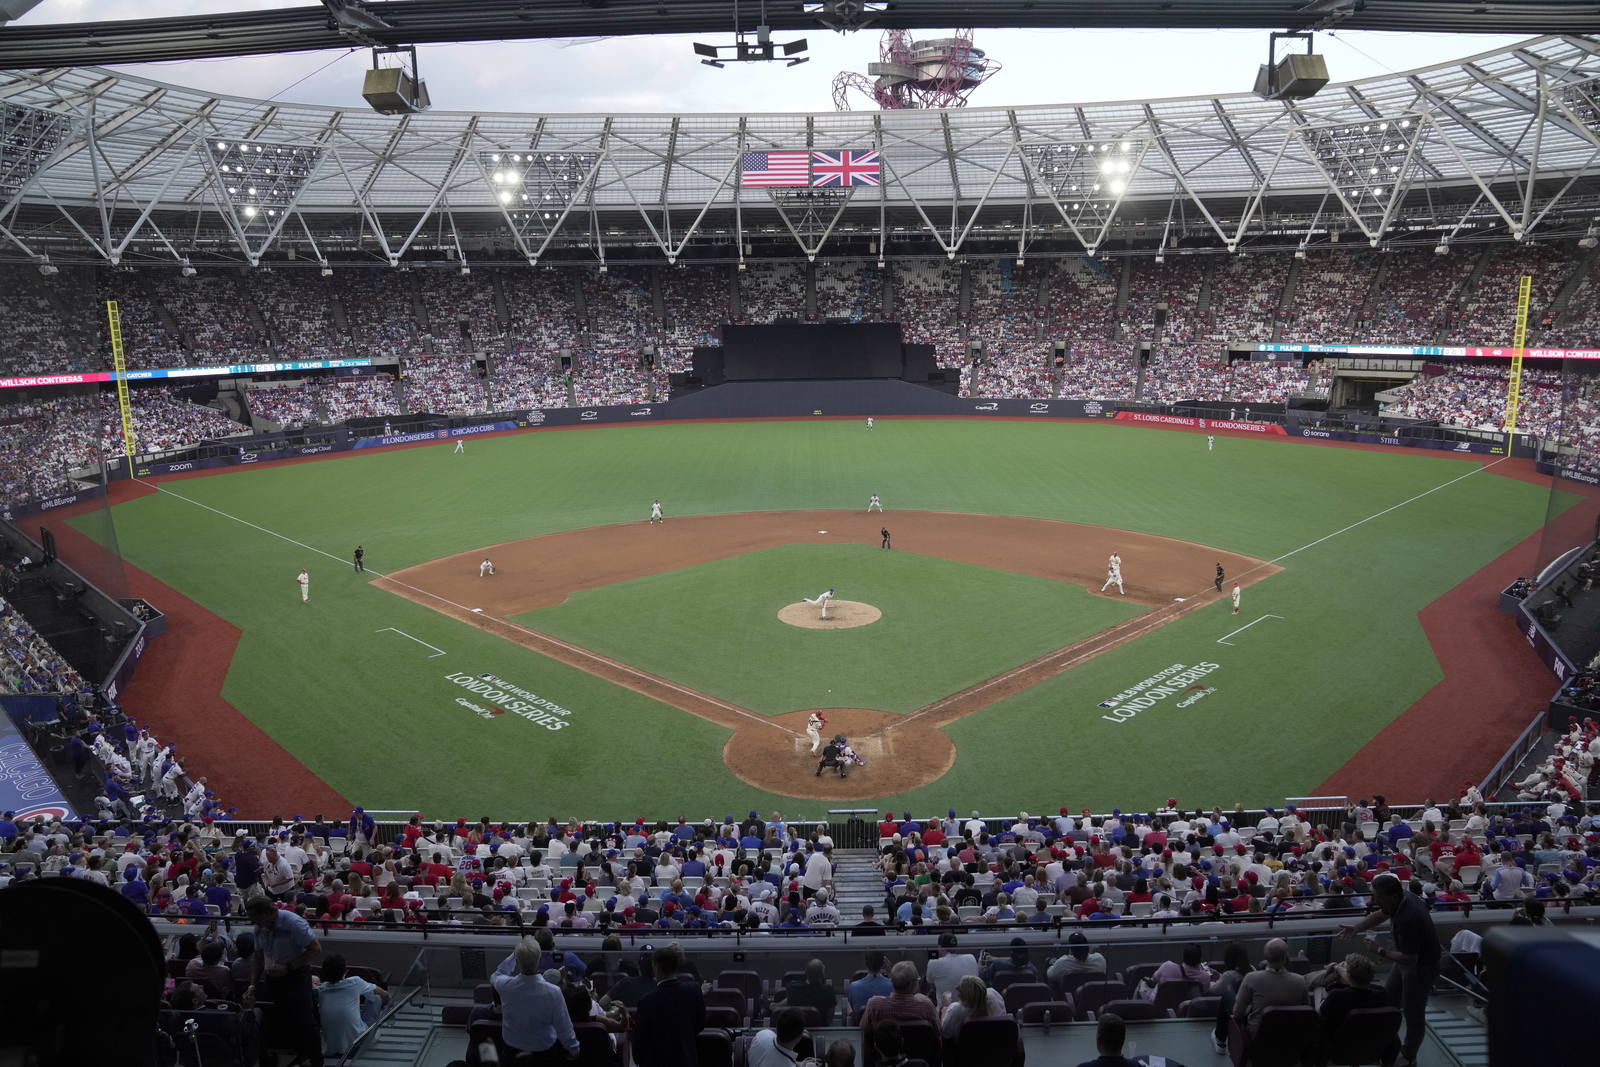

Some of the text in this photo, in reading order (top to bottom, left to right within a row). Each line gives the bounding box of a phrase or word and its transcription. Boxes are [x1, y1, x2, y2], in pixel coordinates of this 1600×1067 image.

[1566, 350, 1600, 358] CONTRE
[0, 375, 83, 386] WILLSON CONTRERAS
[1160, 416, 1194, 426] CARDINALS
[452, 426, 478, 436] CHICAGO
[1211, 422, 1266, 432] #LONDONSERIES
[382, 432, 434, 444] #LONDONSERIES
[170, 462, 192, 471] zoom
[1561, 470, 1598, 484] @MLBEurope
[41, 496, 76, 510] @MLBEurope
[1553, 656, 1565, 680] FOX
[1112, 663, 1187, 702] MLB WORLD TOUR
[491, 678, 571, 716] MLB WORLD TOUR
[1102, 661, 1220, 723] LONDON SERIES
[444, 672, 570, 730] LONDON SERIES
[1360, 813, 1373, 821] 34
[459, 861, 471, 870] 28
[1219, 865, 1226, 874] 4
